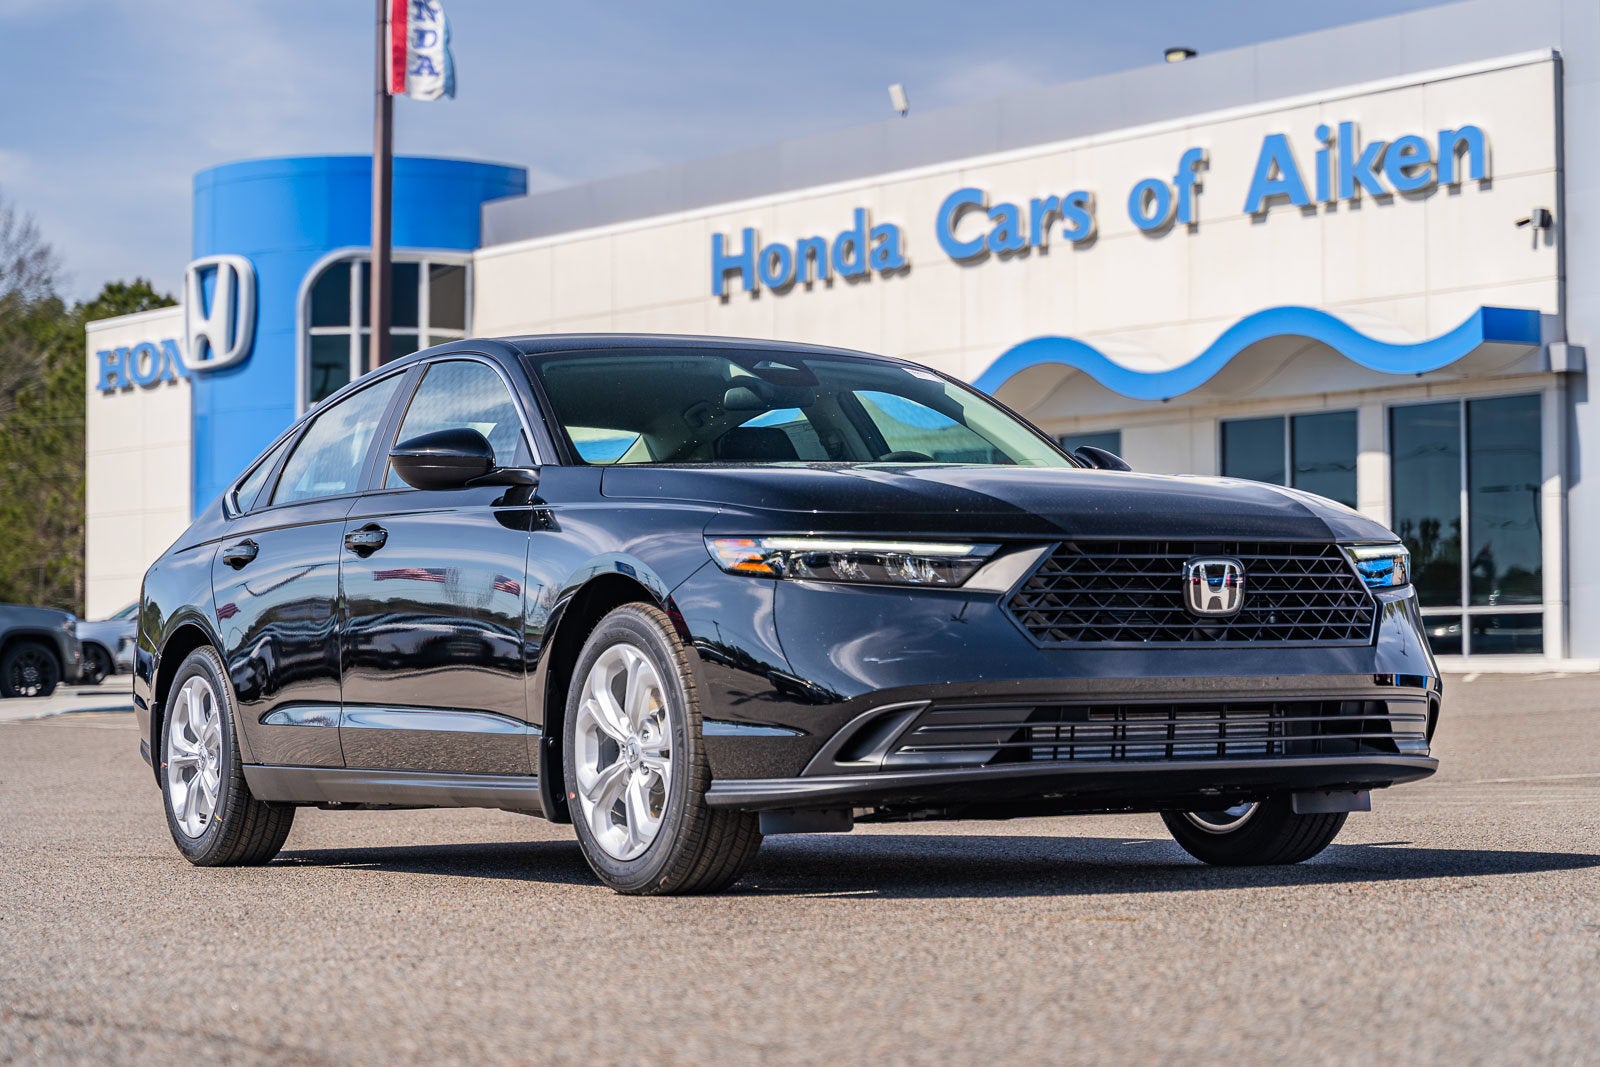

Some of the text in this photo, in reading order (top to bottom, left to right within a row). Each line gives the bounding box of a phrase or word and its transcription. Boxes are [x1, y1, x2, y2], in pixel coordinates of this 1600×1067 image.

[711, 121, 1488, 299] Honda Cars of Aiken
